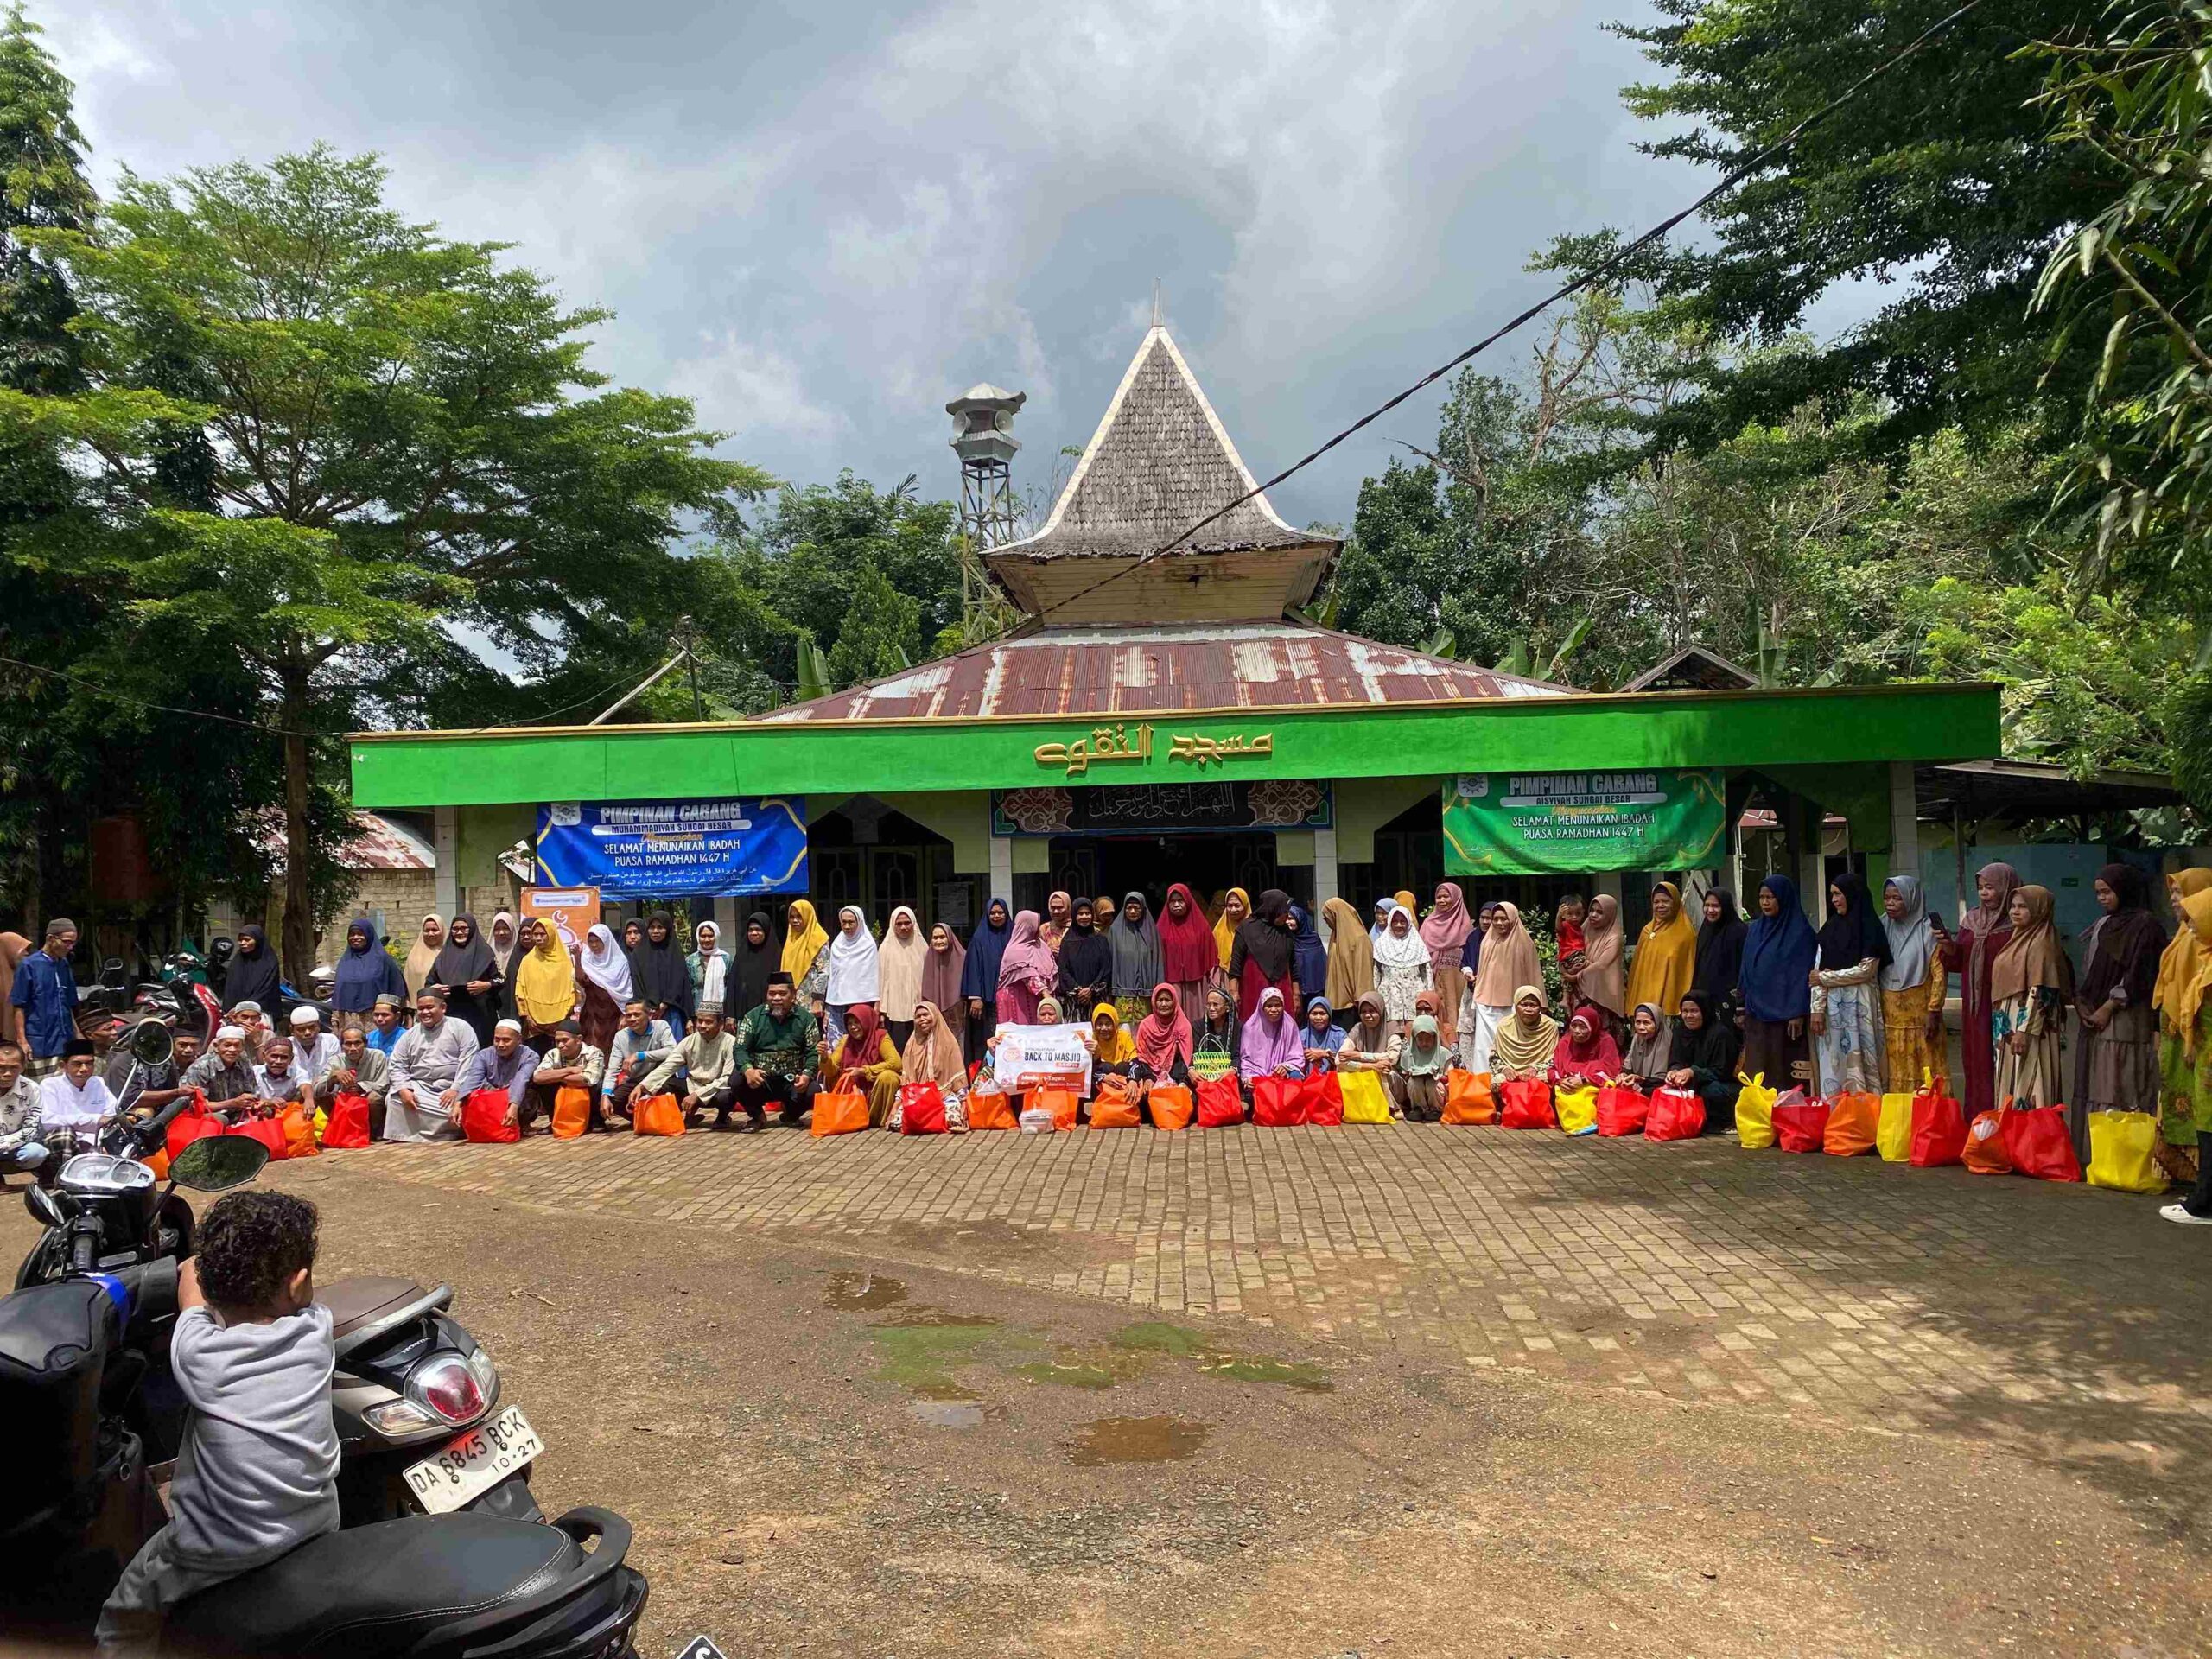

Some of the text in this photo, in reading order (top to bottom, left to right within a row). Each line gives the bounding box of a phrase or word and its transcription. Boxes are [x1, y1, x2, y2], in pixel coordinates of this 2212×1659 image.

[1169, 732, 1274, 766] مسجد
[1510, 774, 1656, 795] PIMPINAN CABANG
[1536, 795, 1630, 805] AISYIYAH SUNGAI BESAR
[601, 802, 741, 823] PIMPINAN CABANG
[1513, 813, 1655, 827] SELAMAT MENUNAIKAN IBADAH
[612, 823, 675, 834] MUHAMMADIYAH
[677, 823, 705, 831] SUNGAI
[1523, 827, 1644, 839] PUASA RAMADHAN 1447 H
[604, 840, 740, 855] SELAMAT MENUNAIKAN IBADAH
[614, 853, 729, 867] PUASA RAMADHAN 1447 H
[1024, 1052, 1081, 1062] BACK TO MASJID
[411, 1412, 526, 1493] DA 6845 BCK
